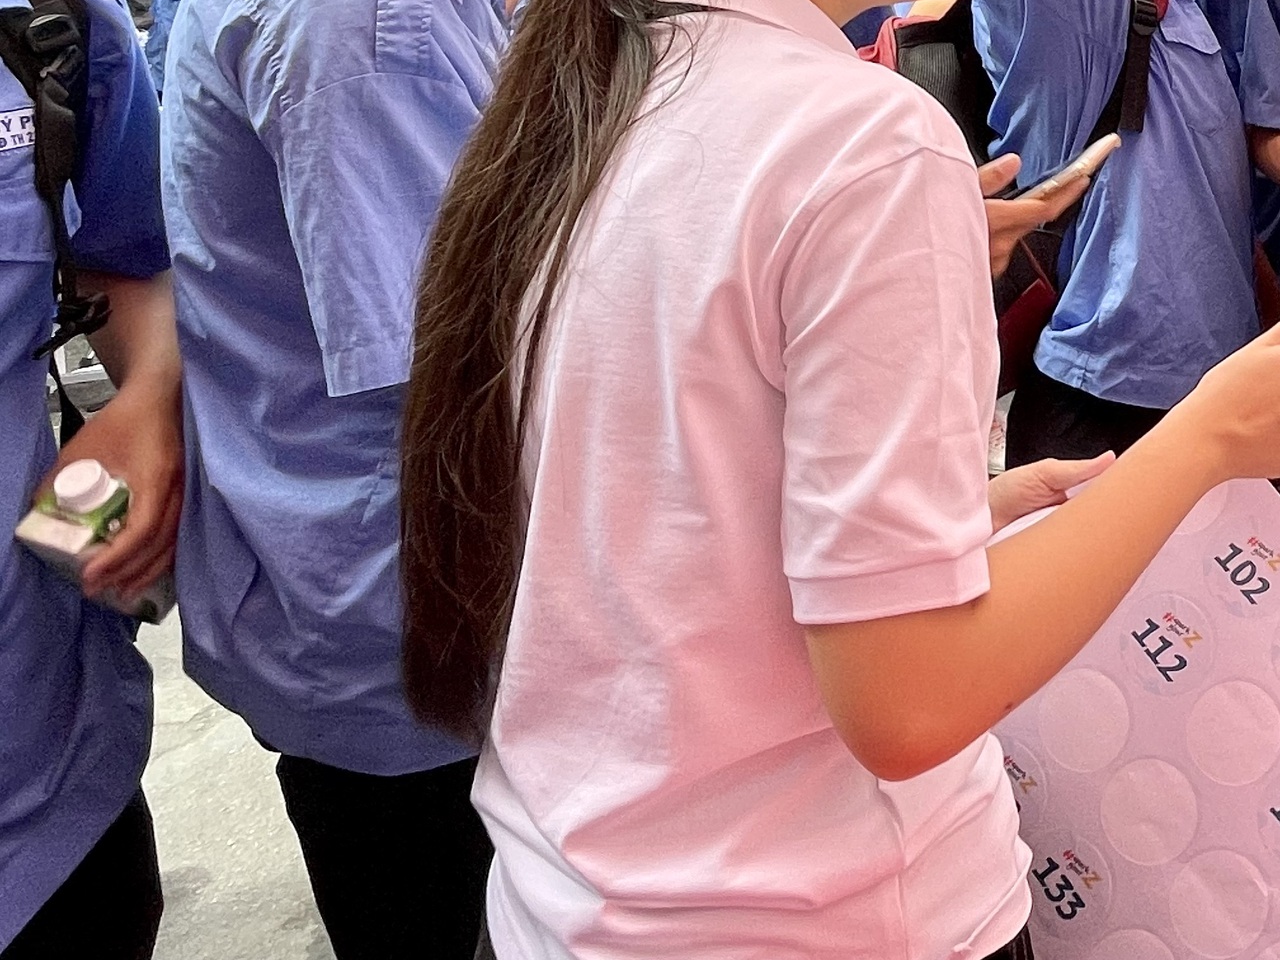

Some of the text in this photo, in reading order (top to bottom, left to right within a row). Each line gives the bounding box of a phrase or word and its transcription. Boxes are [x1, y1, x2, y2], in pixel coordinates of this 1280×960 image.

[1214, 542, 1270, 606] 102
[1131, 618, 1187, 683] 112
[1032, 857, 1086, 920] 133
